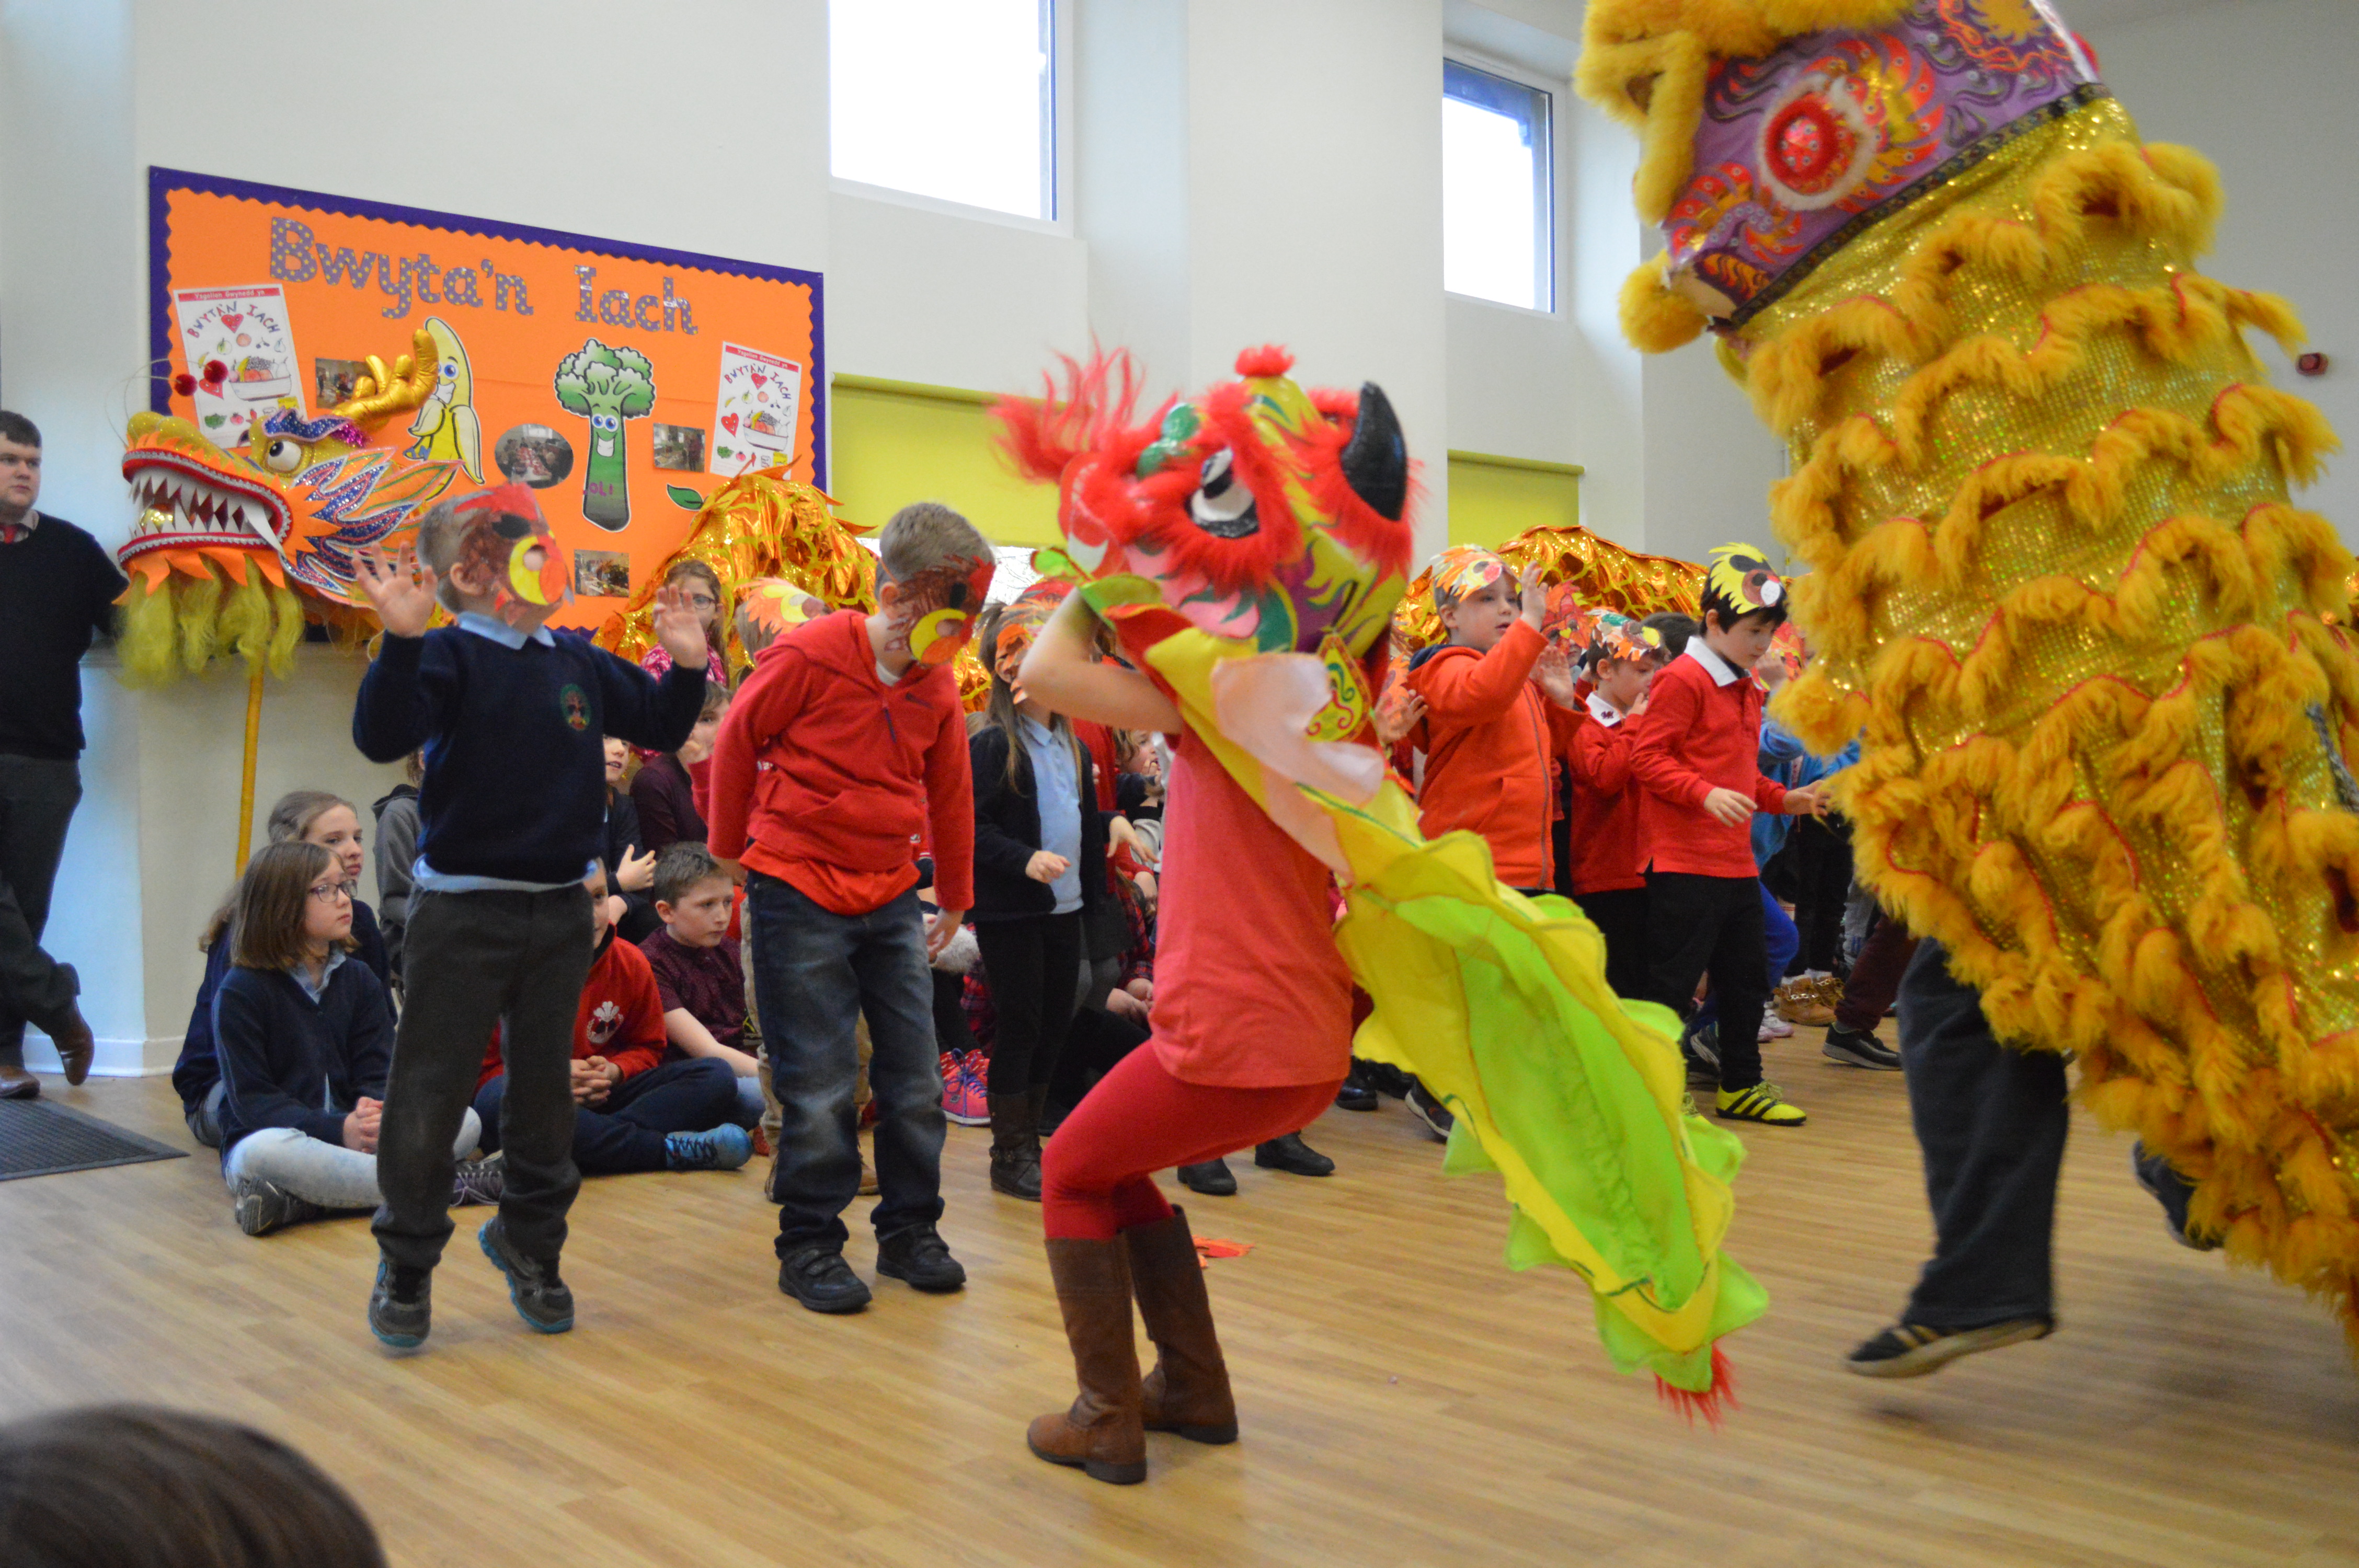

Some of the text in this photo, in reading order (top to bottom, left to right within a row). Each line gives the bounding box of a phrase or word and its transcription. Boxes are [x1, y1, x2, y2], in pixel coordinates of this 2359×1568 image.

[270, 217, 698, 335] Bwyta'n Iach
[194, 292, 223, 301] Ysgolion
[225, 290, 254, 298] Gwynedd
[247, 304, 281, 333] IACH
[770, 372, 792, 399] IACH
